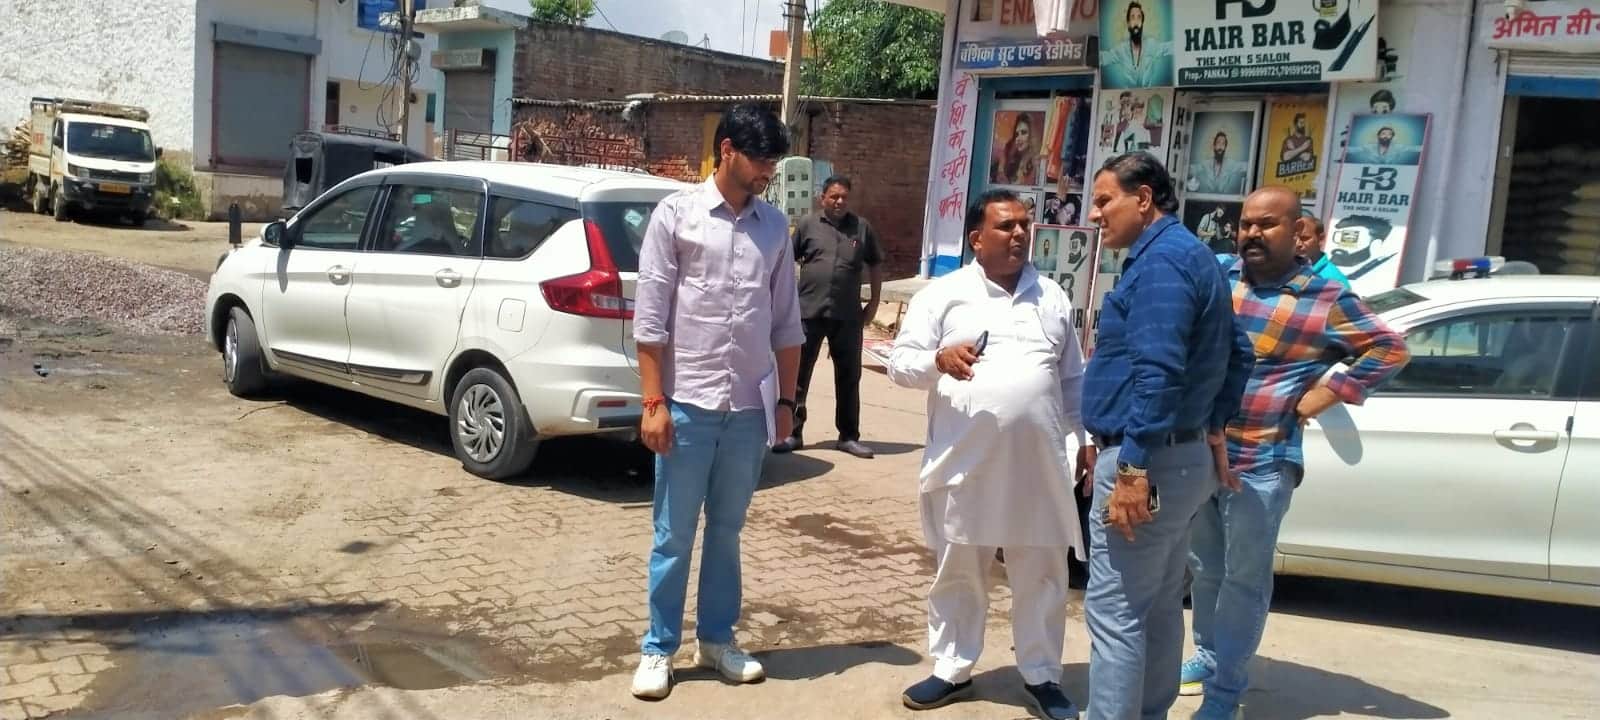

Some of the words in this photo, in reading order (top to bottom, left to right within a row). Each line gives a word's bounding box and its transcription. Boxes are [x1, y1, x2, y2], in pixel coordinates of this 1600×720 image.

[1492, 10, 1562, 39] अमित
[1566, 7, 1600, 35] सी
[1184, 25, 1244, 52] HAIR
[1251, 20, 1306, 47] BAR
[960, 43, 995, 63] वंशिका
[998, 45, 1017, 67] सूट
[1018, 44, 1043, 60] एण्ड
[1043, 40, 1083, 60] रेडीमेड
[1195, 57, 1216, 67] THE
[1218, 55, 1241, 65] MEN
[1255, 52, 1290, 63] SALON
[1203, 69, 1230, 79] PANKAJ
[1337, 191, 1374, 205] HAIR
[1378, 193, 1410, 206] BAR
